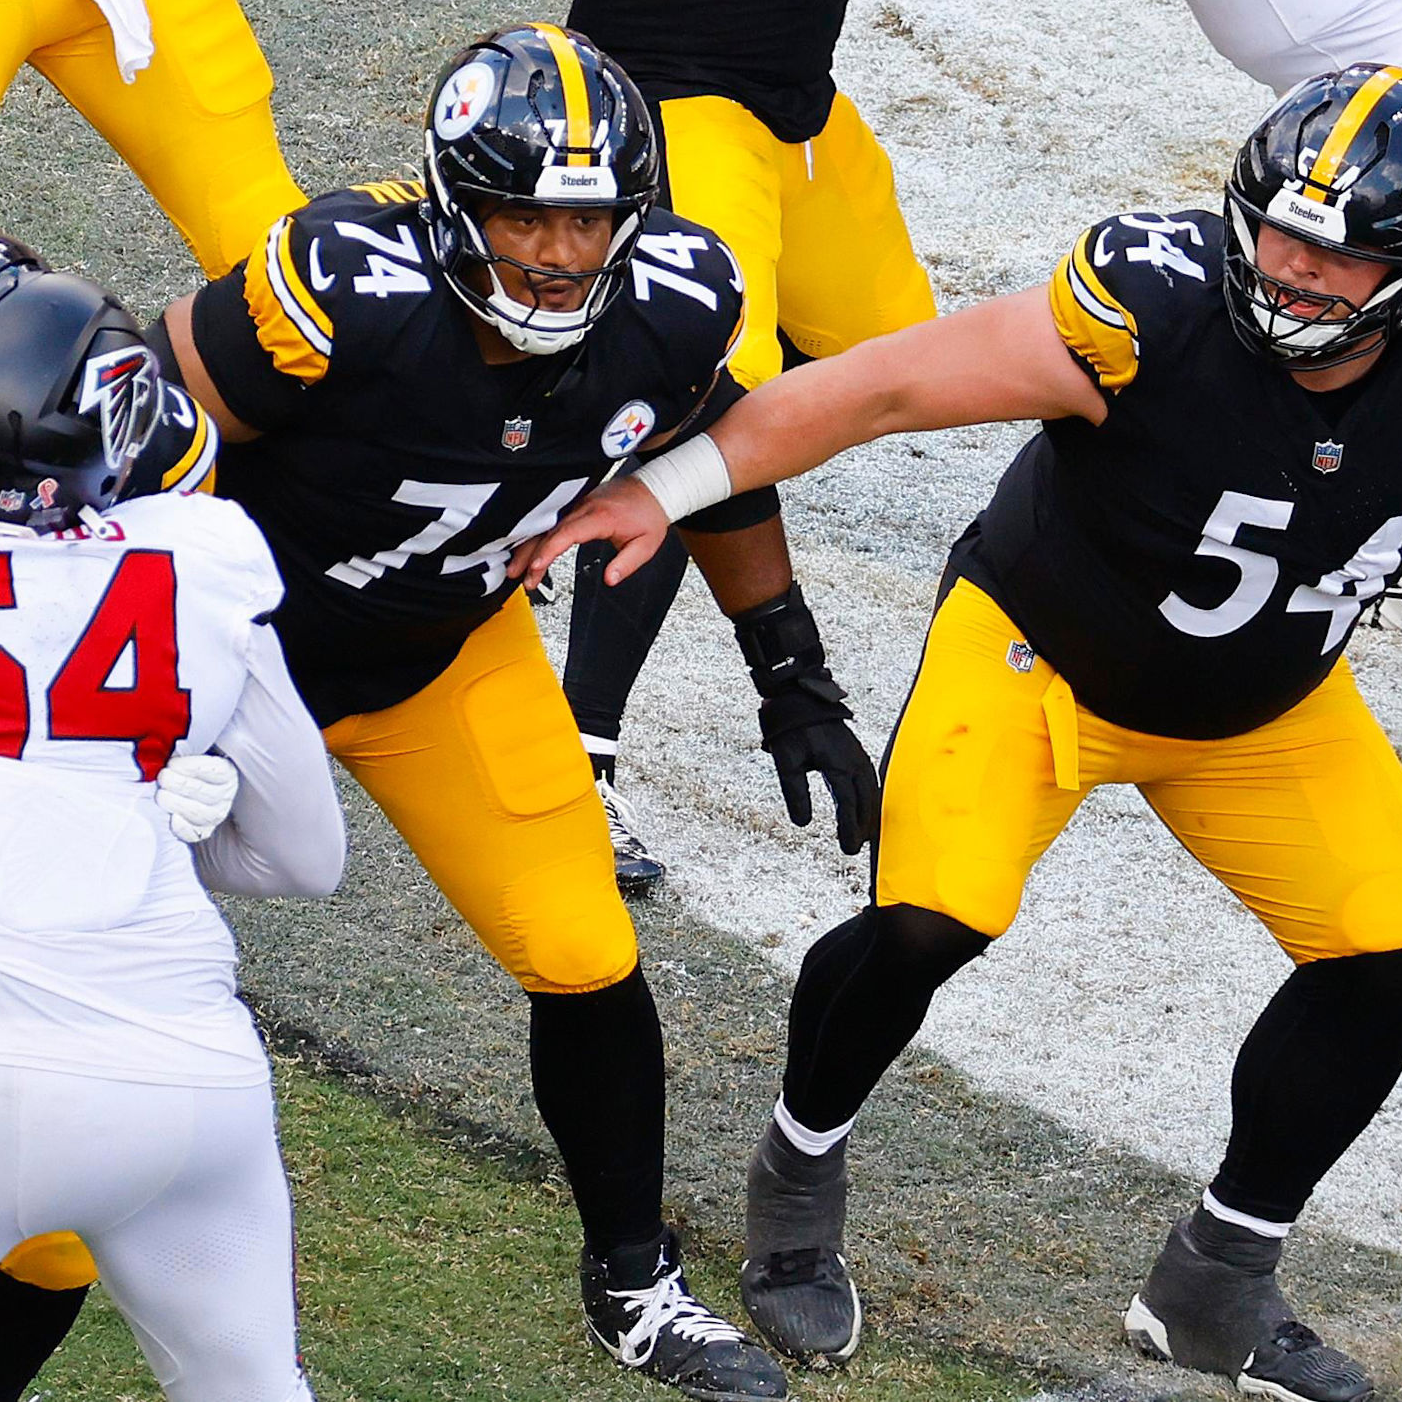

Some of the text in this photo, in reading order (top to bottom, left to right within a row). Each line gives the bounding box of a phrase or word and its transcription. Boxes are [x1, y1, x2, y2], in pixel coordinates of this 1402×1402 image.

[560, 174, 598, 186] Steelers
[1288, 201, 1326, 224] Steelers
[333, 221, 432, 298] 74
[631, 231, 717, 311] 74
